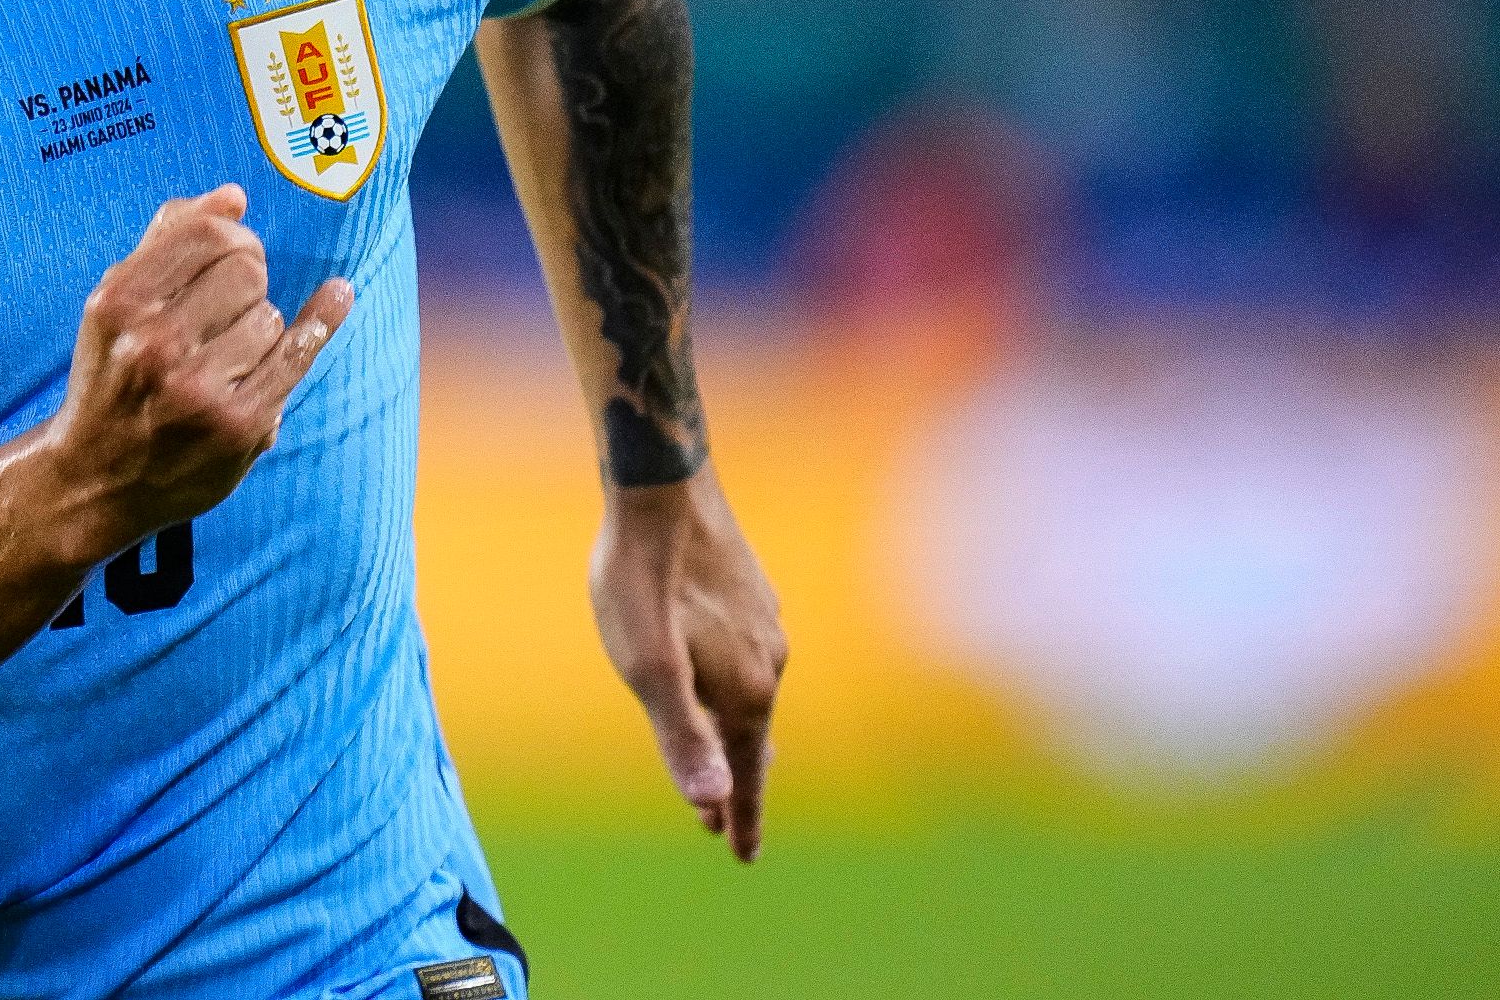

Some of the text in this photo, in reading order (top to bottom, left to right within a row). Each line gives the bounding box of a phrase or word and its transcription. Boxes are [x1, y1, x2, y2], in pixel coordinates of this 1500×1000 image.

[19, 56, 152, 121] VS. PANAMÁ
[296, 41, 334, 110] AUF
[40, 113, 156, 164] MIAMI GARDENS
[52, 98, 133, 135] 23 JUNIO 2024
